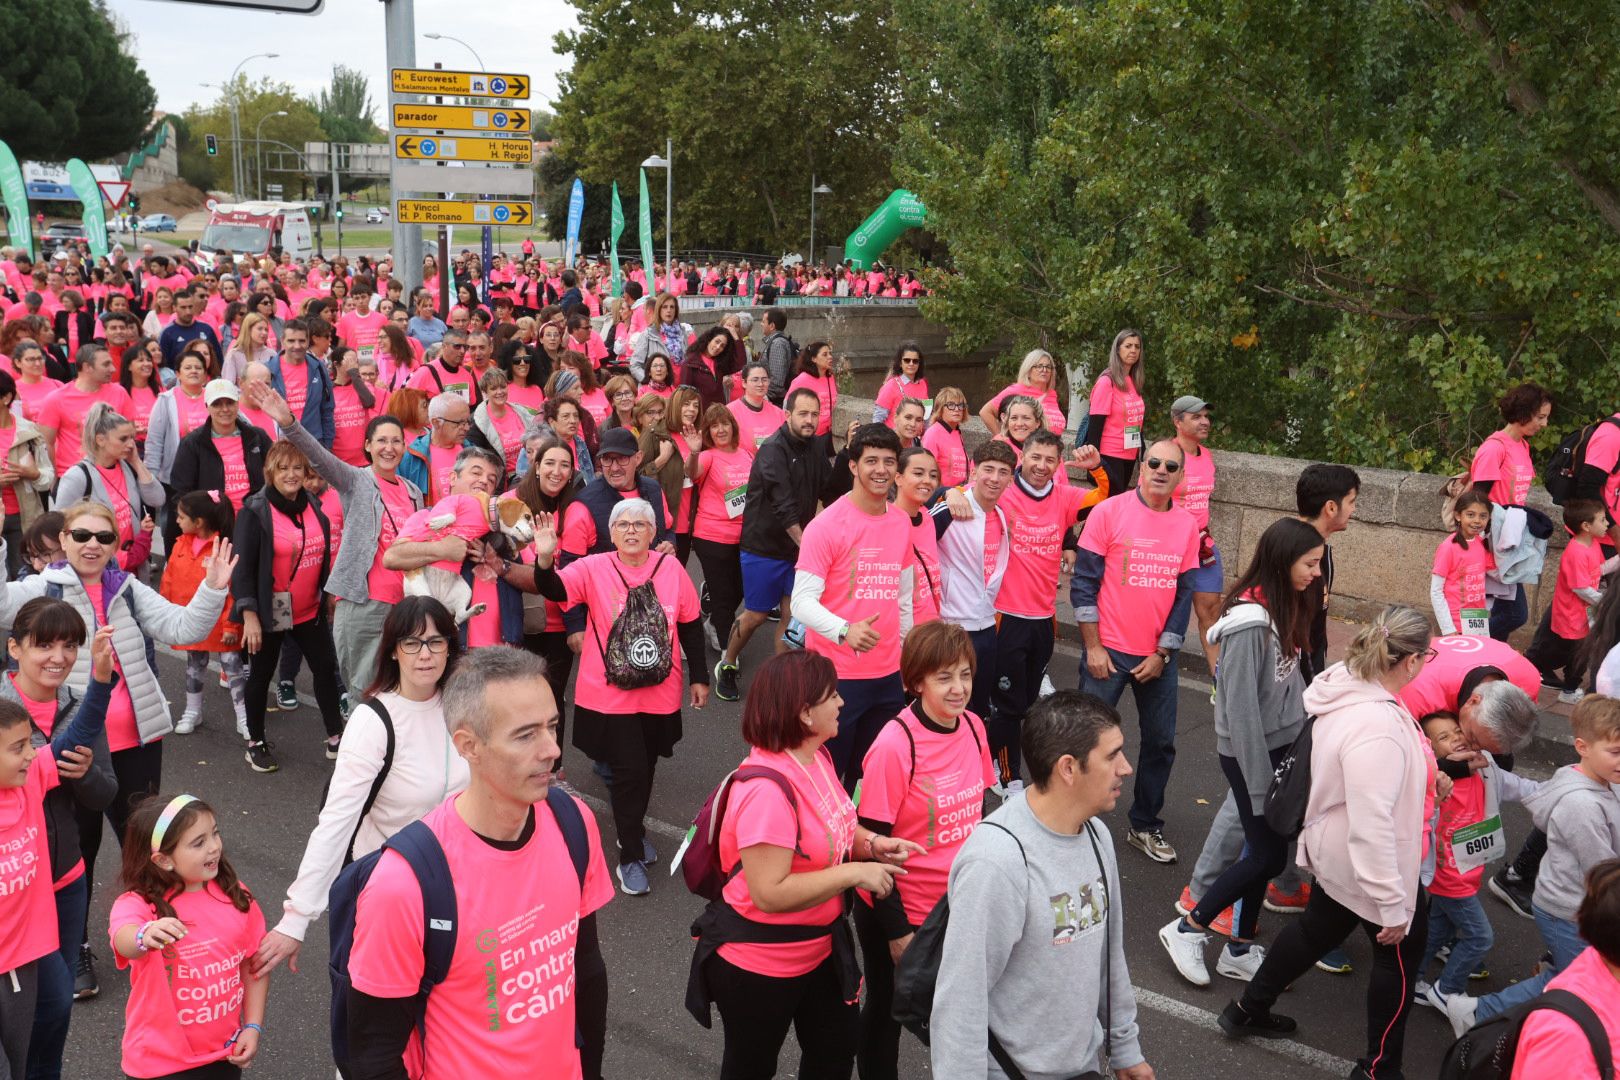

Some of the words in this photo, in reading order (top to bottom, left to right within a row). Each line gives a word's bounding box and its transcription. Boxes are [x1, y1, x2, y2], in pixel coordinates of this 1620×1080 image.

[394, 73, 404, 81] H.
[410, 73, 458, 83] Eurowest
[397, 111, 438, 121] parador
[502, 142, 529, 151] Horus
[504, 151, 529, 161] Regio
[400, 203, 409, 211] H.
[413, 203, 440, 211] Vincci
[425, 213, 462, 221] Romano
[1131, 549, 1144, 560] En
[857, 561, 872, 571] En
[1129, 562, 1170, 575] contra
[857, 572, 893, 585] contra
[937, 794, 955, 809] En
[938, 801, 982, 826] contra
[1465, 834, 1494, 856] 6901
[500, 946, 526, 971] En
[177, 964, 201, 980] En
[501, 946, 575, 996] contra
[176, 970, 241, 1001] contra
[506, 972, 576, 1024] cánc
[177, 987, 245, 1025] cánce
